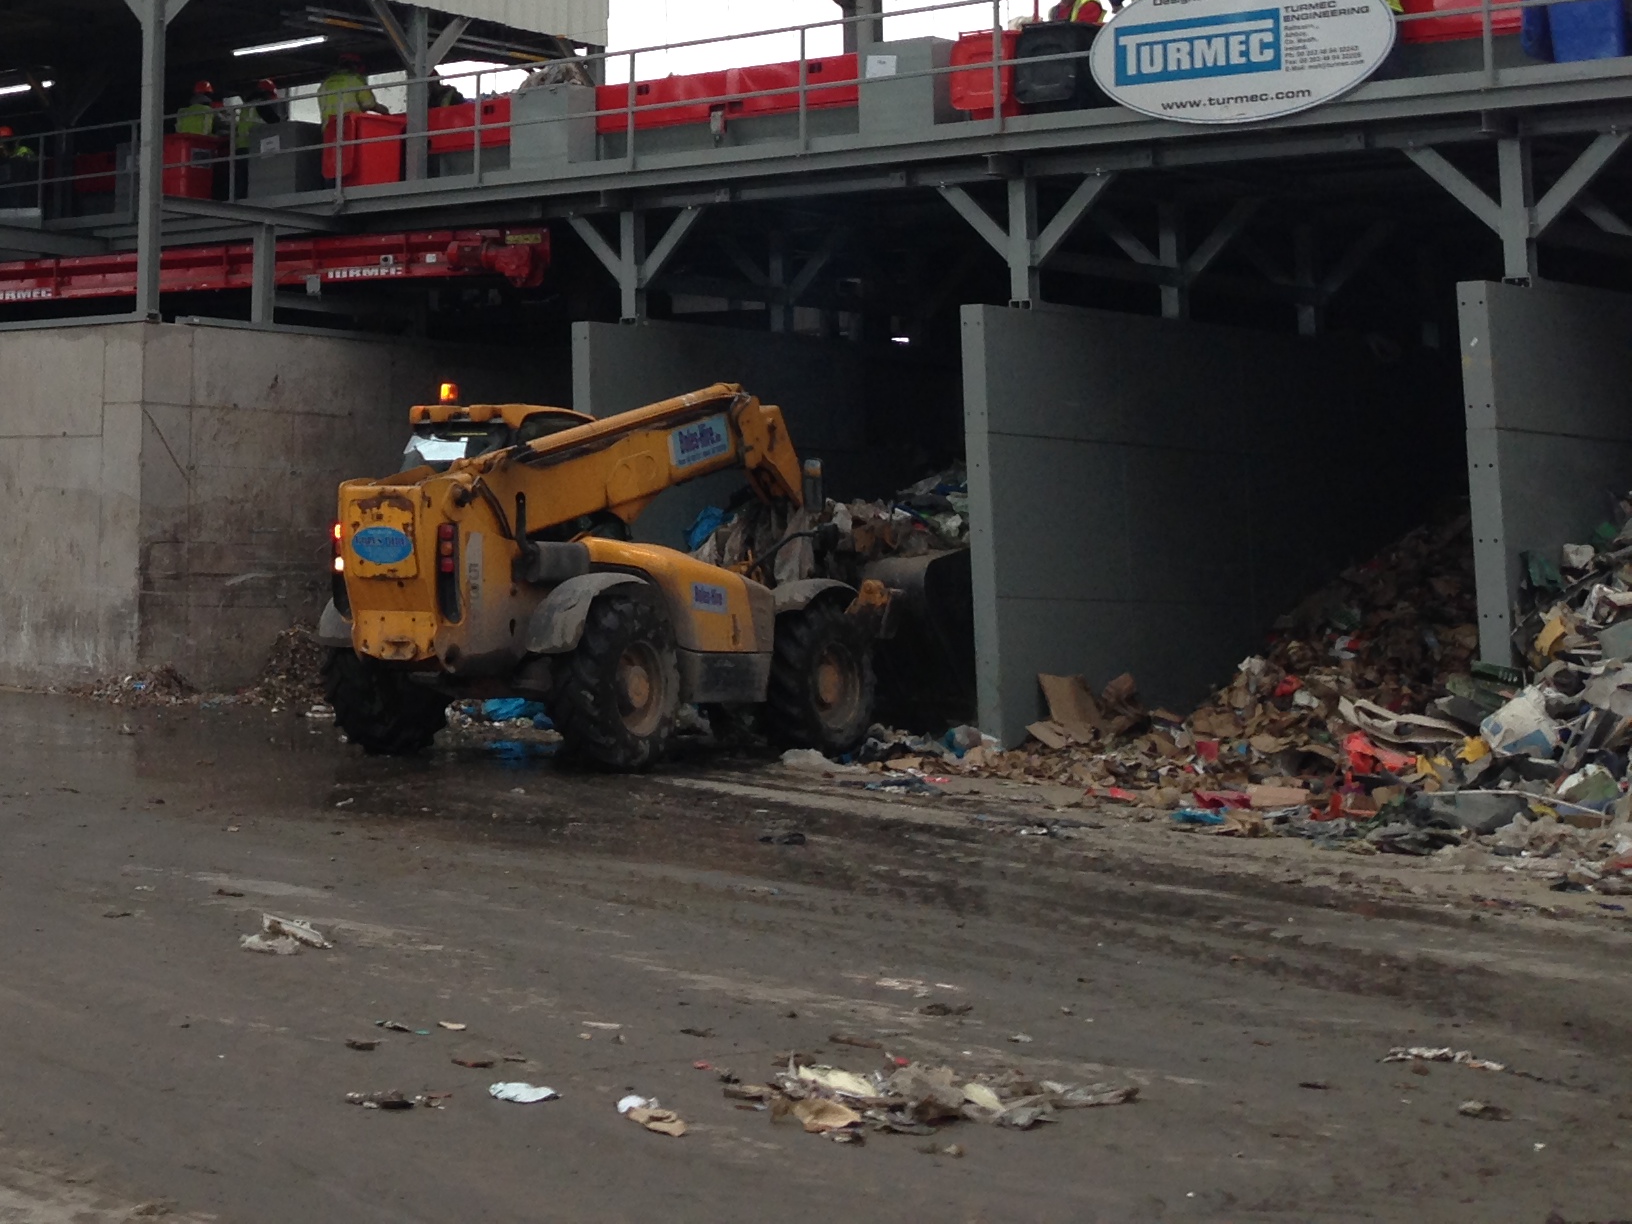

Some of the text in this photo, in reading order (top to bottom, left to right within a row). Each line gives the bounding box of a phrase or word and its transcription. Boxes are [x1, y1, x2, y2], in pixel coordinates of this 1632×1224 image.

[1282, 6, 1370, 23] ENGINEERING
[1283, 0, 1337, 14] TURMEC
[1119, 18, 1275, 76] TURMEC
[1161, 88, 1312, 111] www.turmec.com
